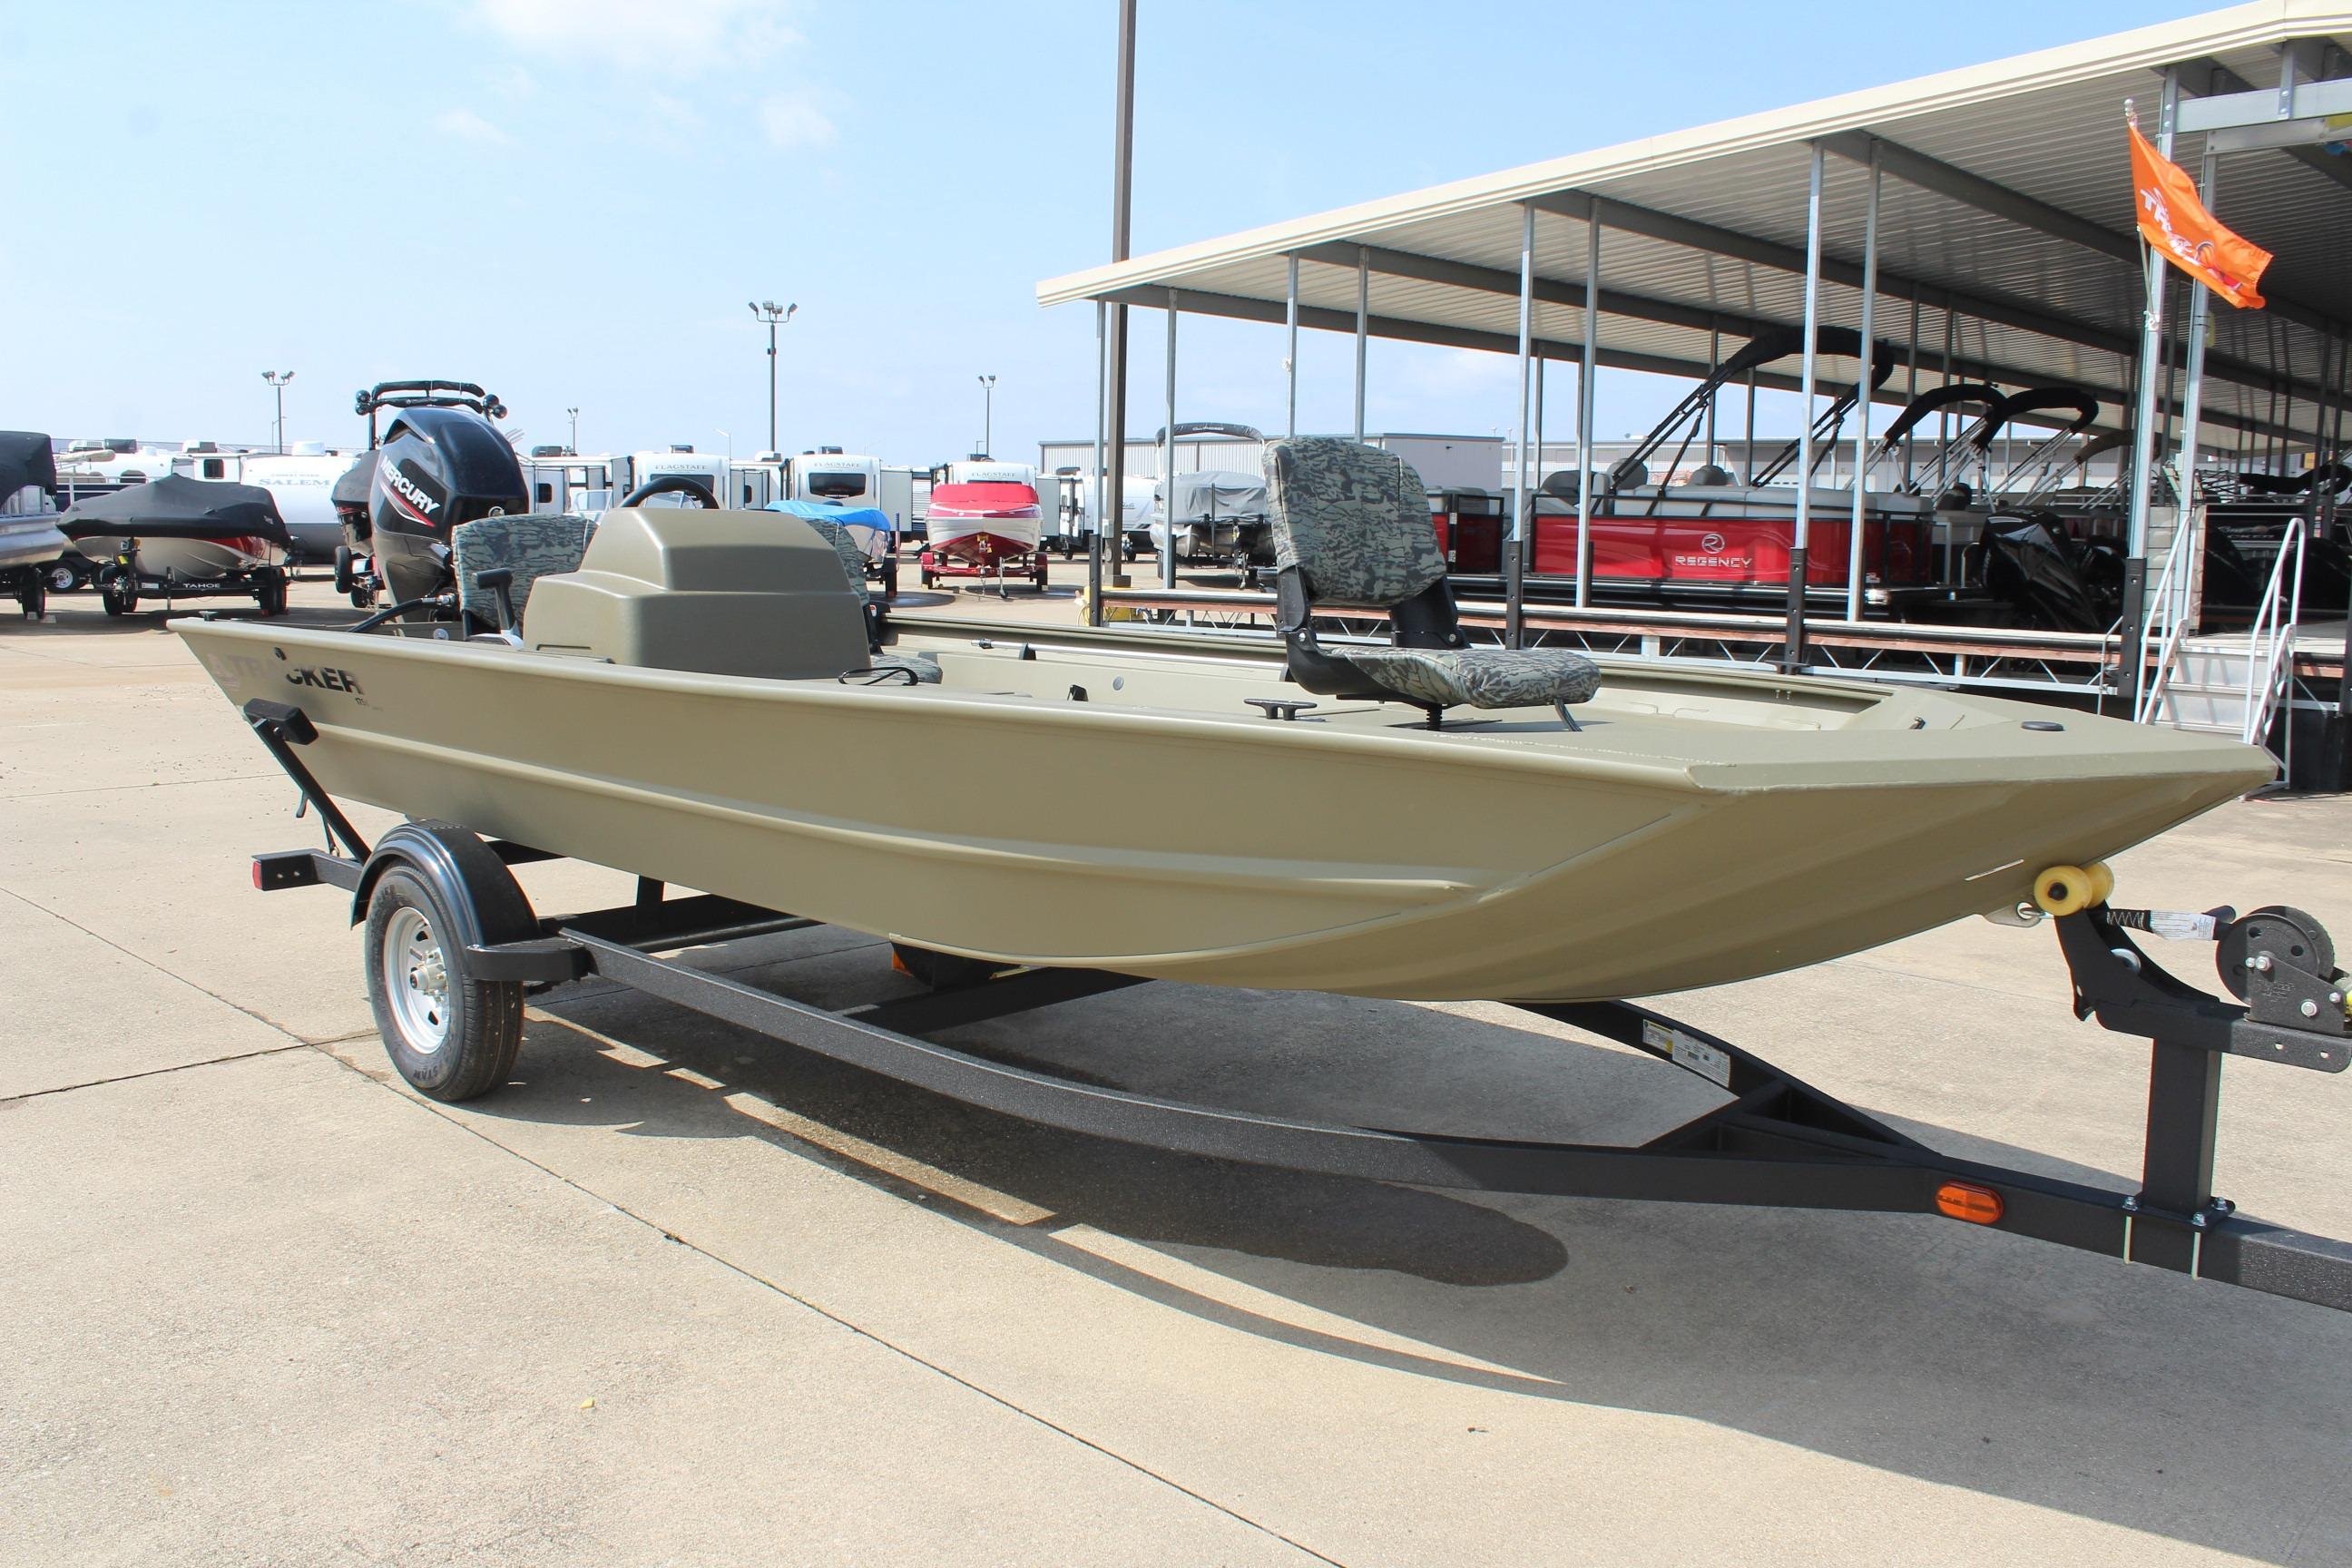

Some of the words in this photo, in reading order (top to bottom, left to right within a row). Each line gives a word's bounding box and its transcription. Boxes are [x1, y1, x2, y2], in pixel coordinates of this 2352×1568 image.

[380, 455, 441, 514] MERCURY
[1675, 555, 1752, 568] REGENCY
[226, 653, 365, 696] TRCKER
